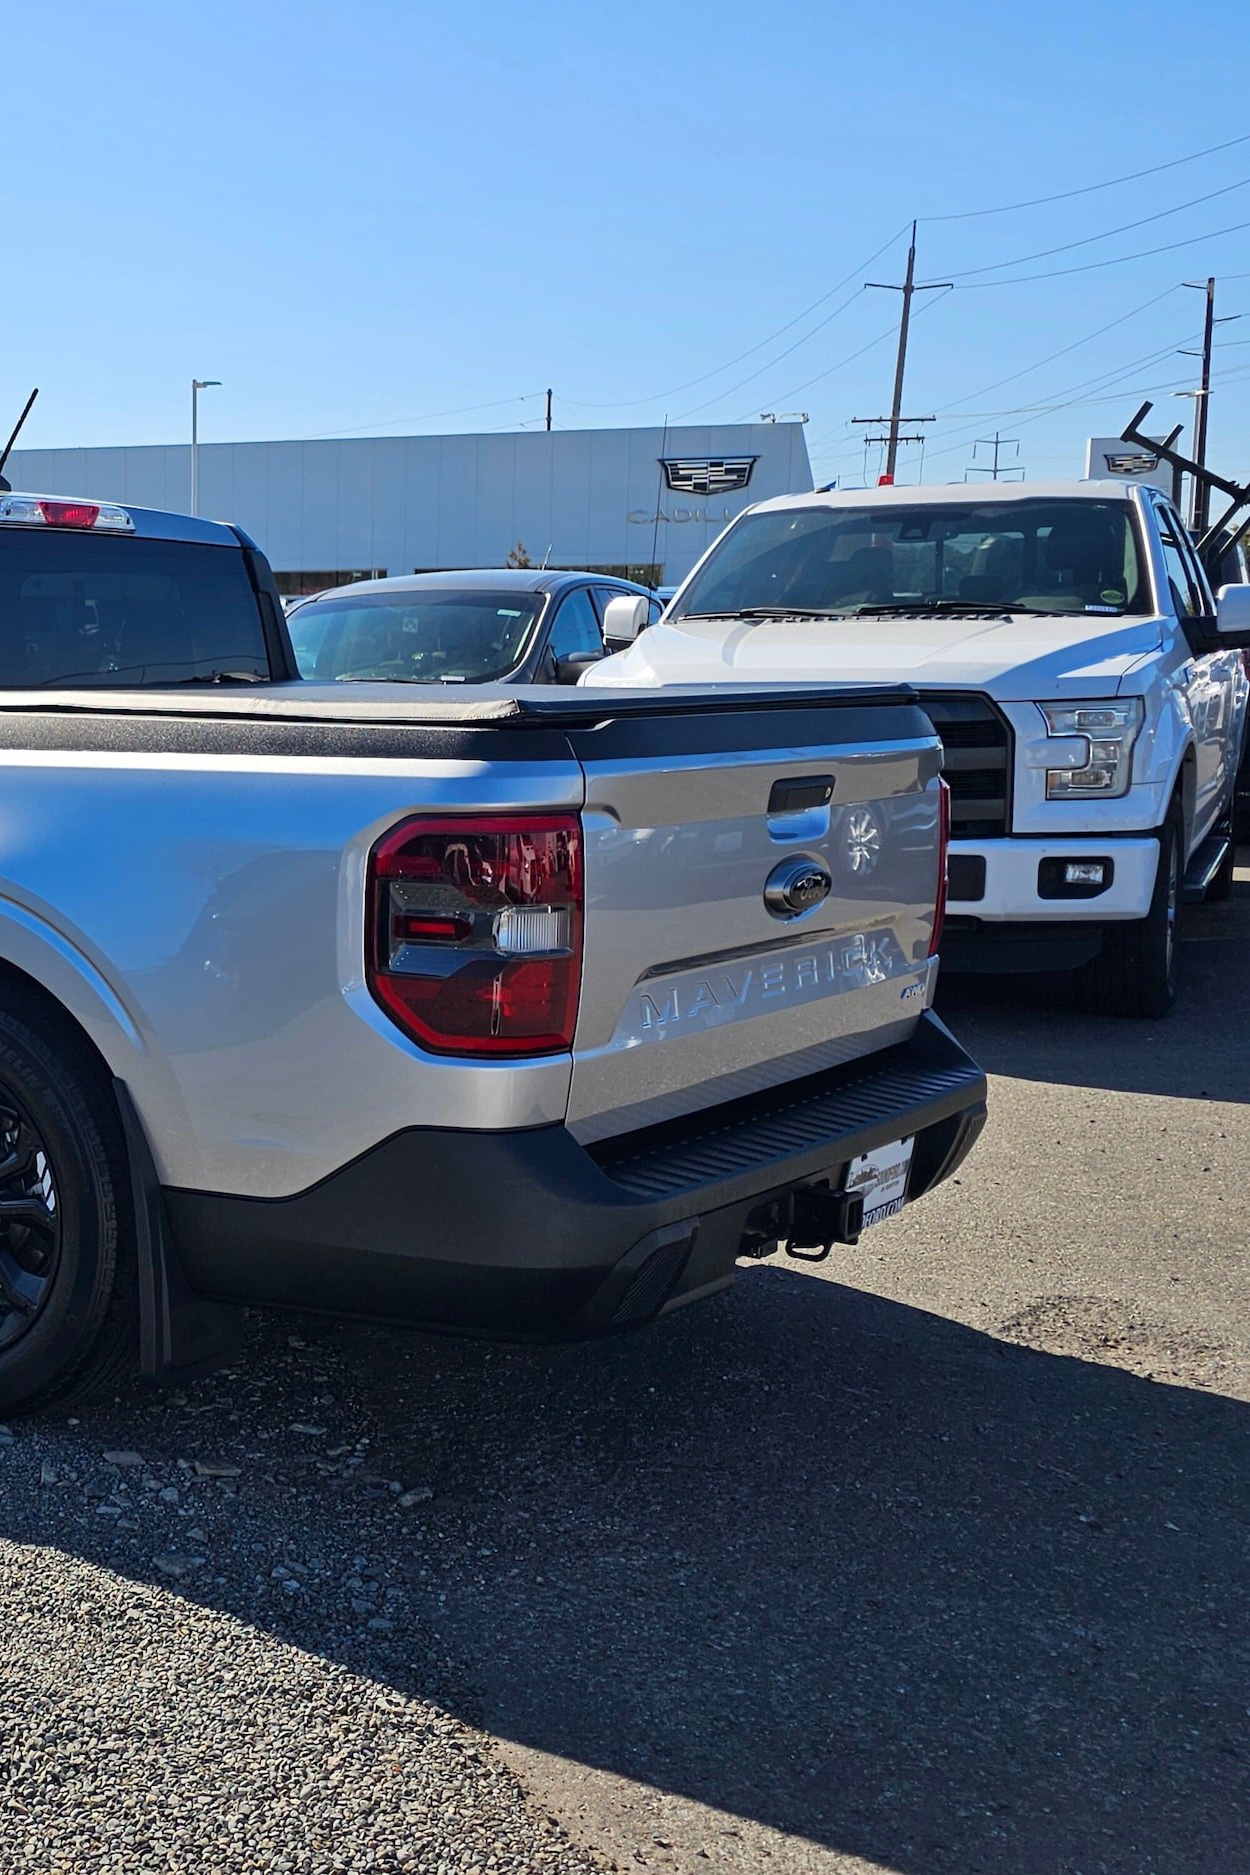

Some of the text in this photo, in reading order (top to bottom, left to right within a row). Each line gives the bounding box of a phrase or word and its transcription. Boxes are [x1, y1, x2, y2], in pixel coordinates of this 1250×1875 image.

[796, 874, 830, 901] Ford
[640, 933, 894, 1030] MAVERICK
[900, 983, 926, 1000] AWD
